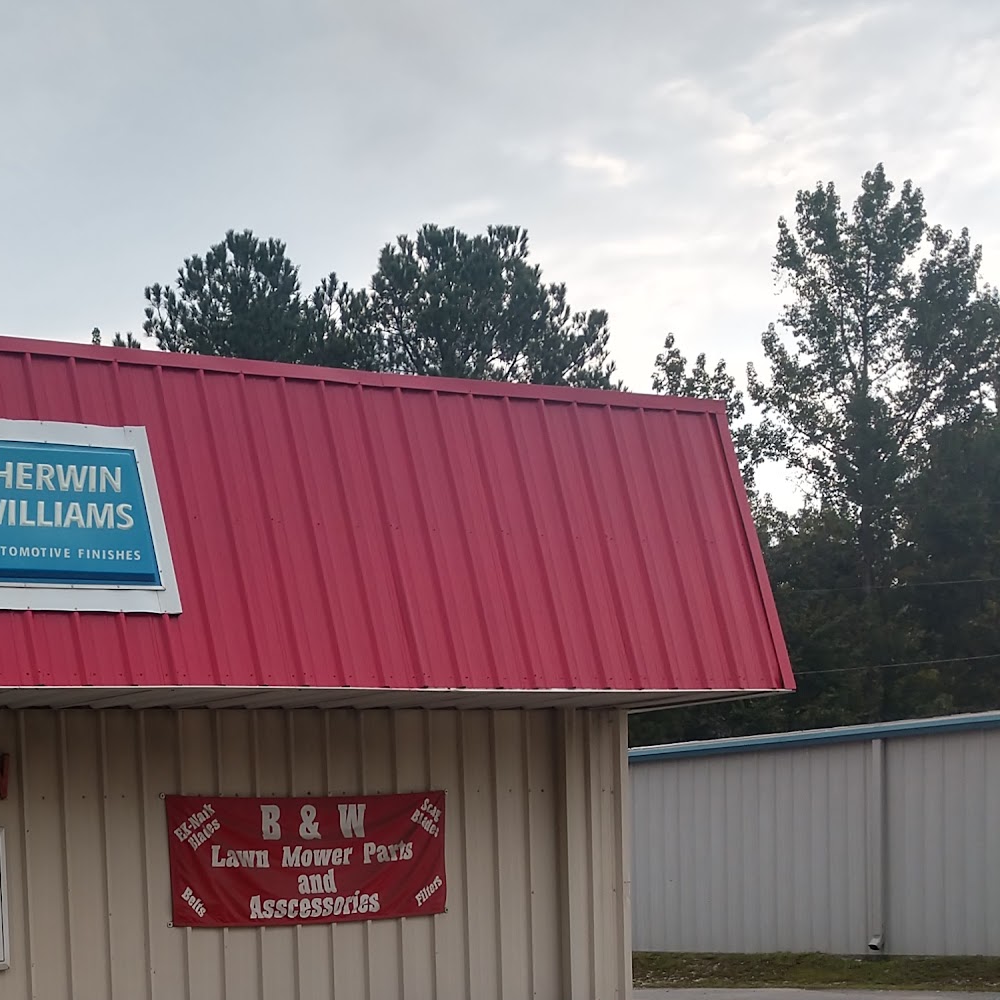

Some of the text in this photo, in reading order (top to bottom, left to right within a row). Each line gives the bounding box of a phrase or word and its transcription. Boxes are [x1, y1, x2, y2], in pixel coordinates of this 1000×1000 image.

[78, 548, 141, 561] FINISHES
[260, 803, 366, 840] B & W
[211, 839, 413, 869] Lawn Mower Parts
[297, 868, 337, 895] and
[414, 875, 443, 906] Filters
[181, 886, 208, 918] Belts
[250, 890, 381, 919] Asscessories
